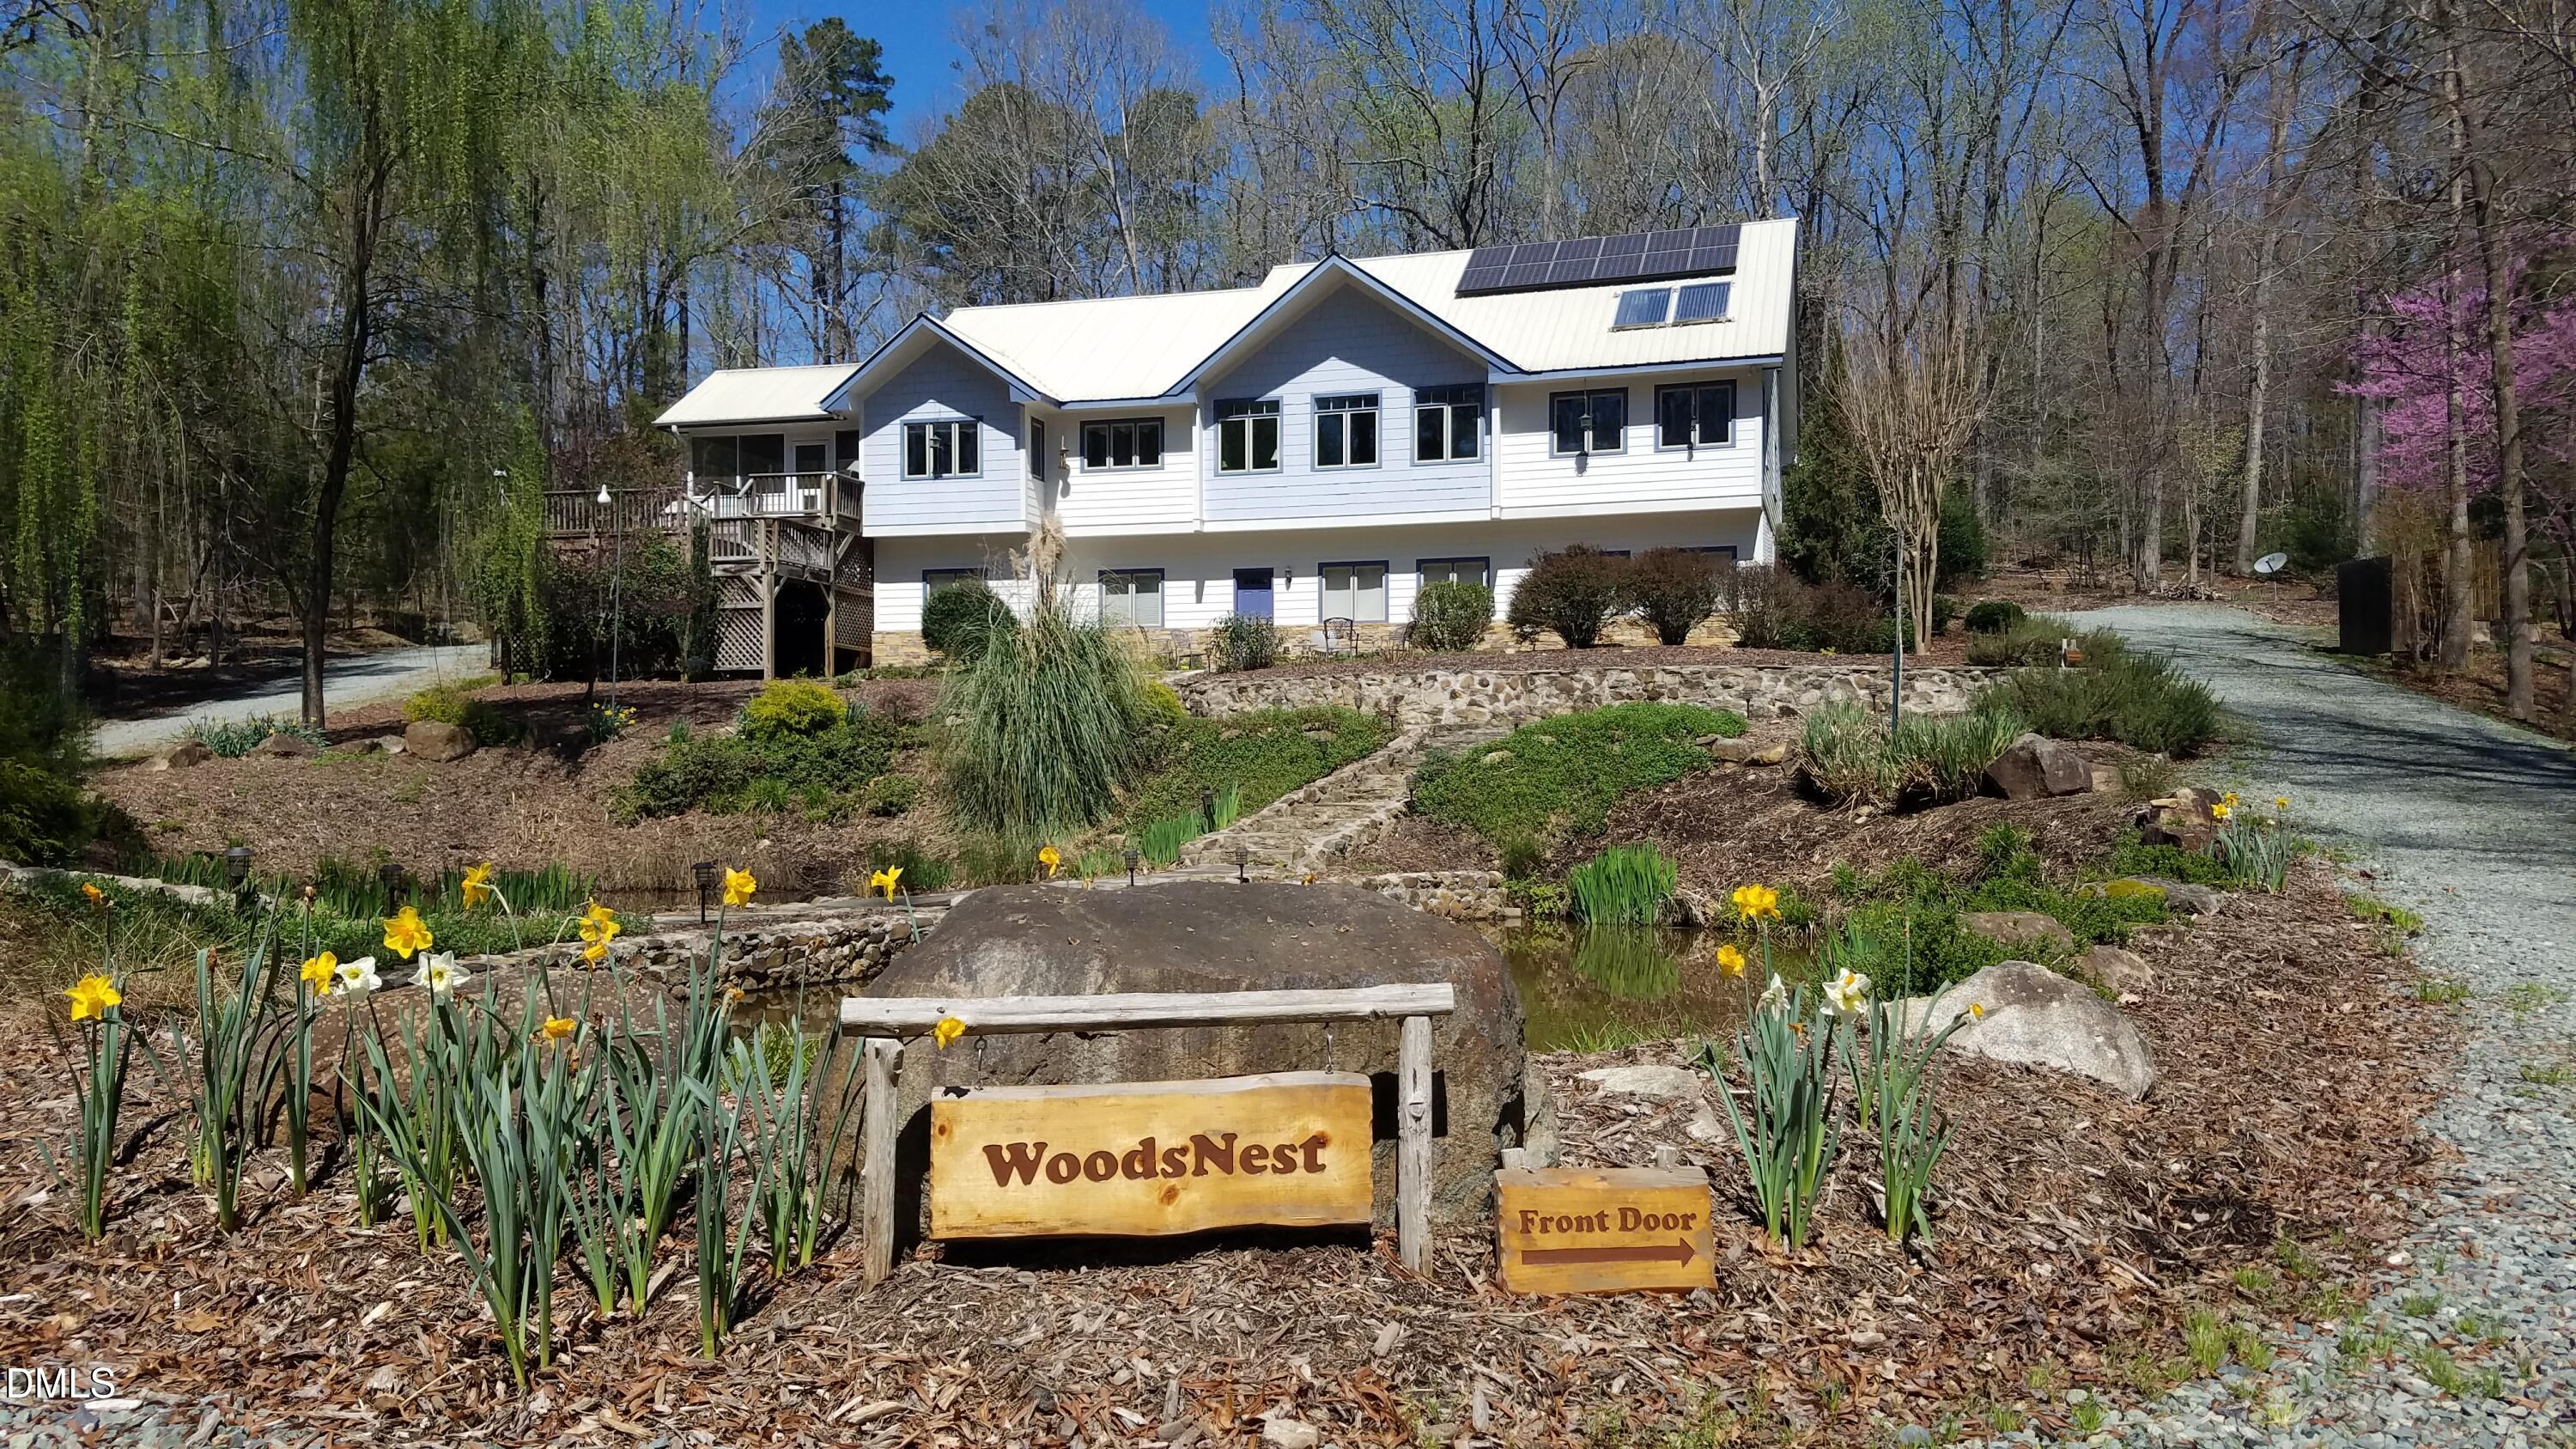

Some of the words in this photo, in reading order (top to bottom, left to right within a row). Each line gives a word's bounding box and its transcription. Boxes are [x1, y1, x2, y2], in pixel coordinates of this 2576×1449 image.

[983, 1132, 1327, 1187] WoodsNest
[1518, 1209, 1610, 1234] Front
[1618, 1207, 1697, 1232] Door
